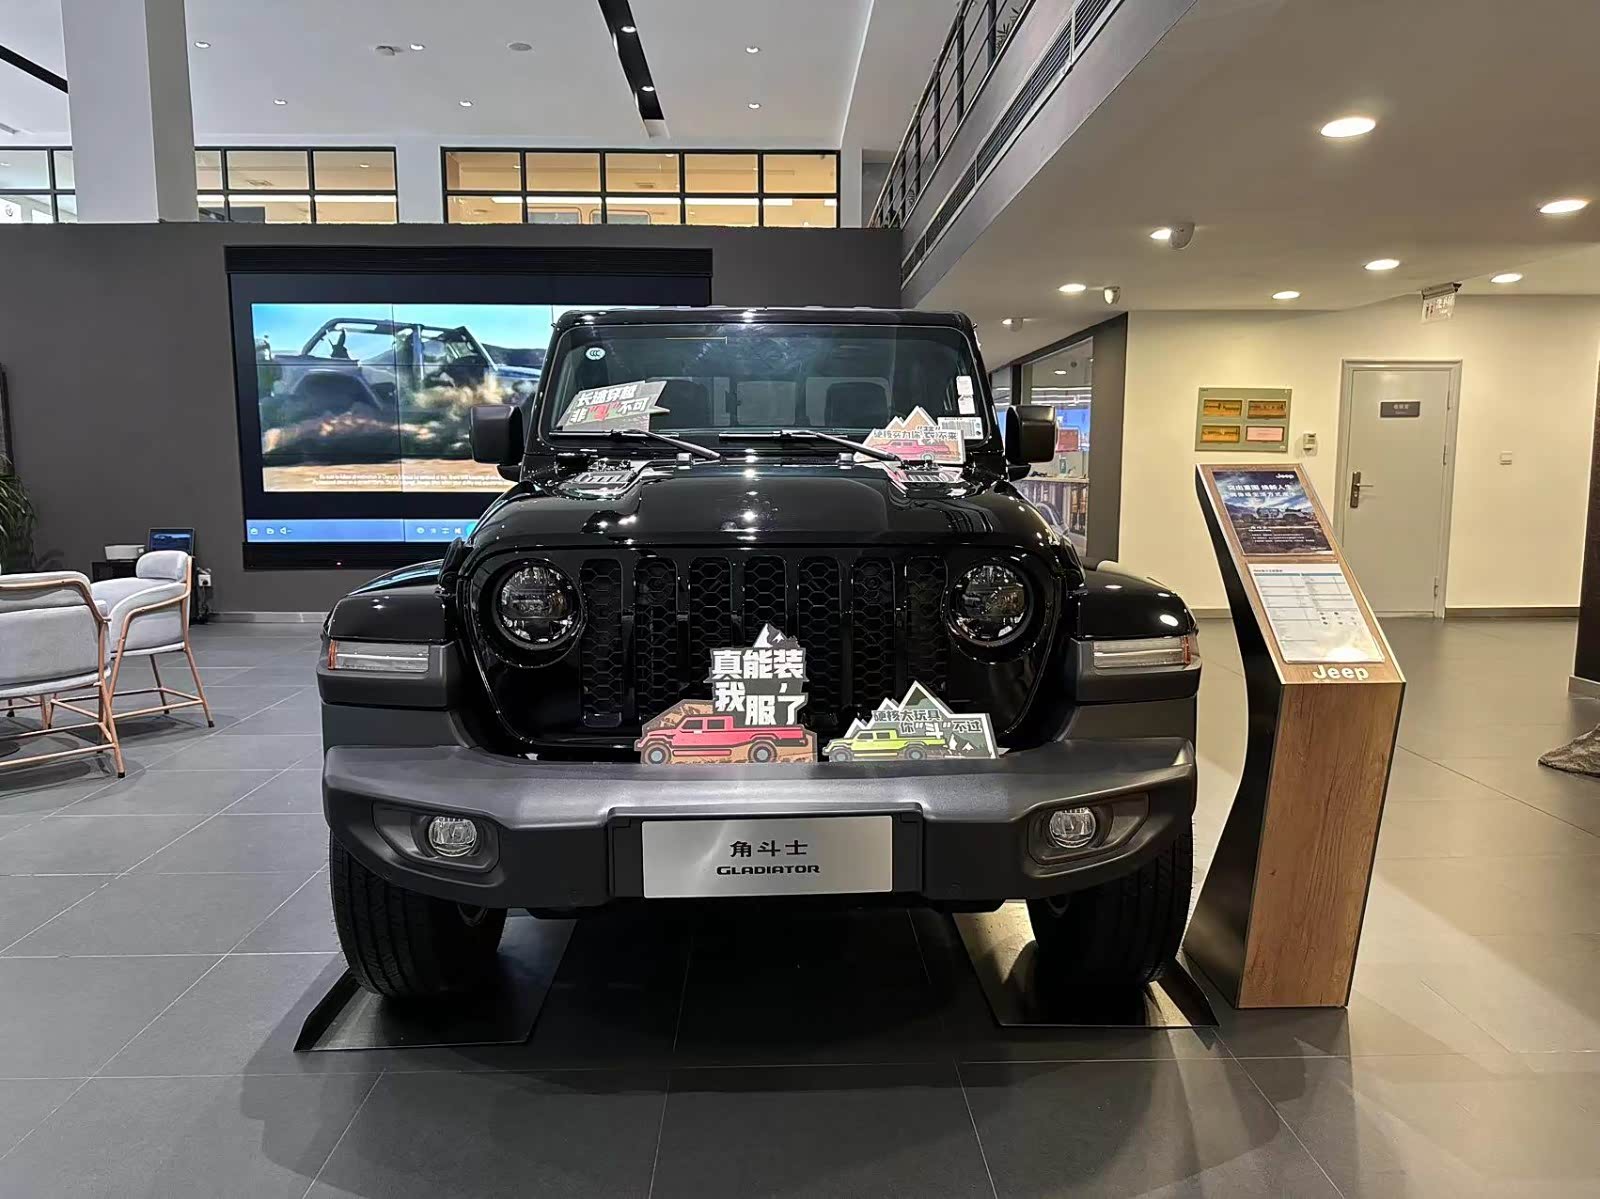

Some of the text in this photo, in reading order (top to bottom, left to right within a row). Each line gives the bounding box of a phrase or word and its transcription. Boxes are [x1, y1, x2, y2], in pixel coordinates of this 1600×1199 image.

[711, 649, 804, 680] 真能装
[1312, 664, 1369, 681] Jeep
[872, 709, 941, 722] 硬核大玩具
[729, 839, 809, 858] 角斗士
[716, 864, 821, 876] GLADIATOR
